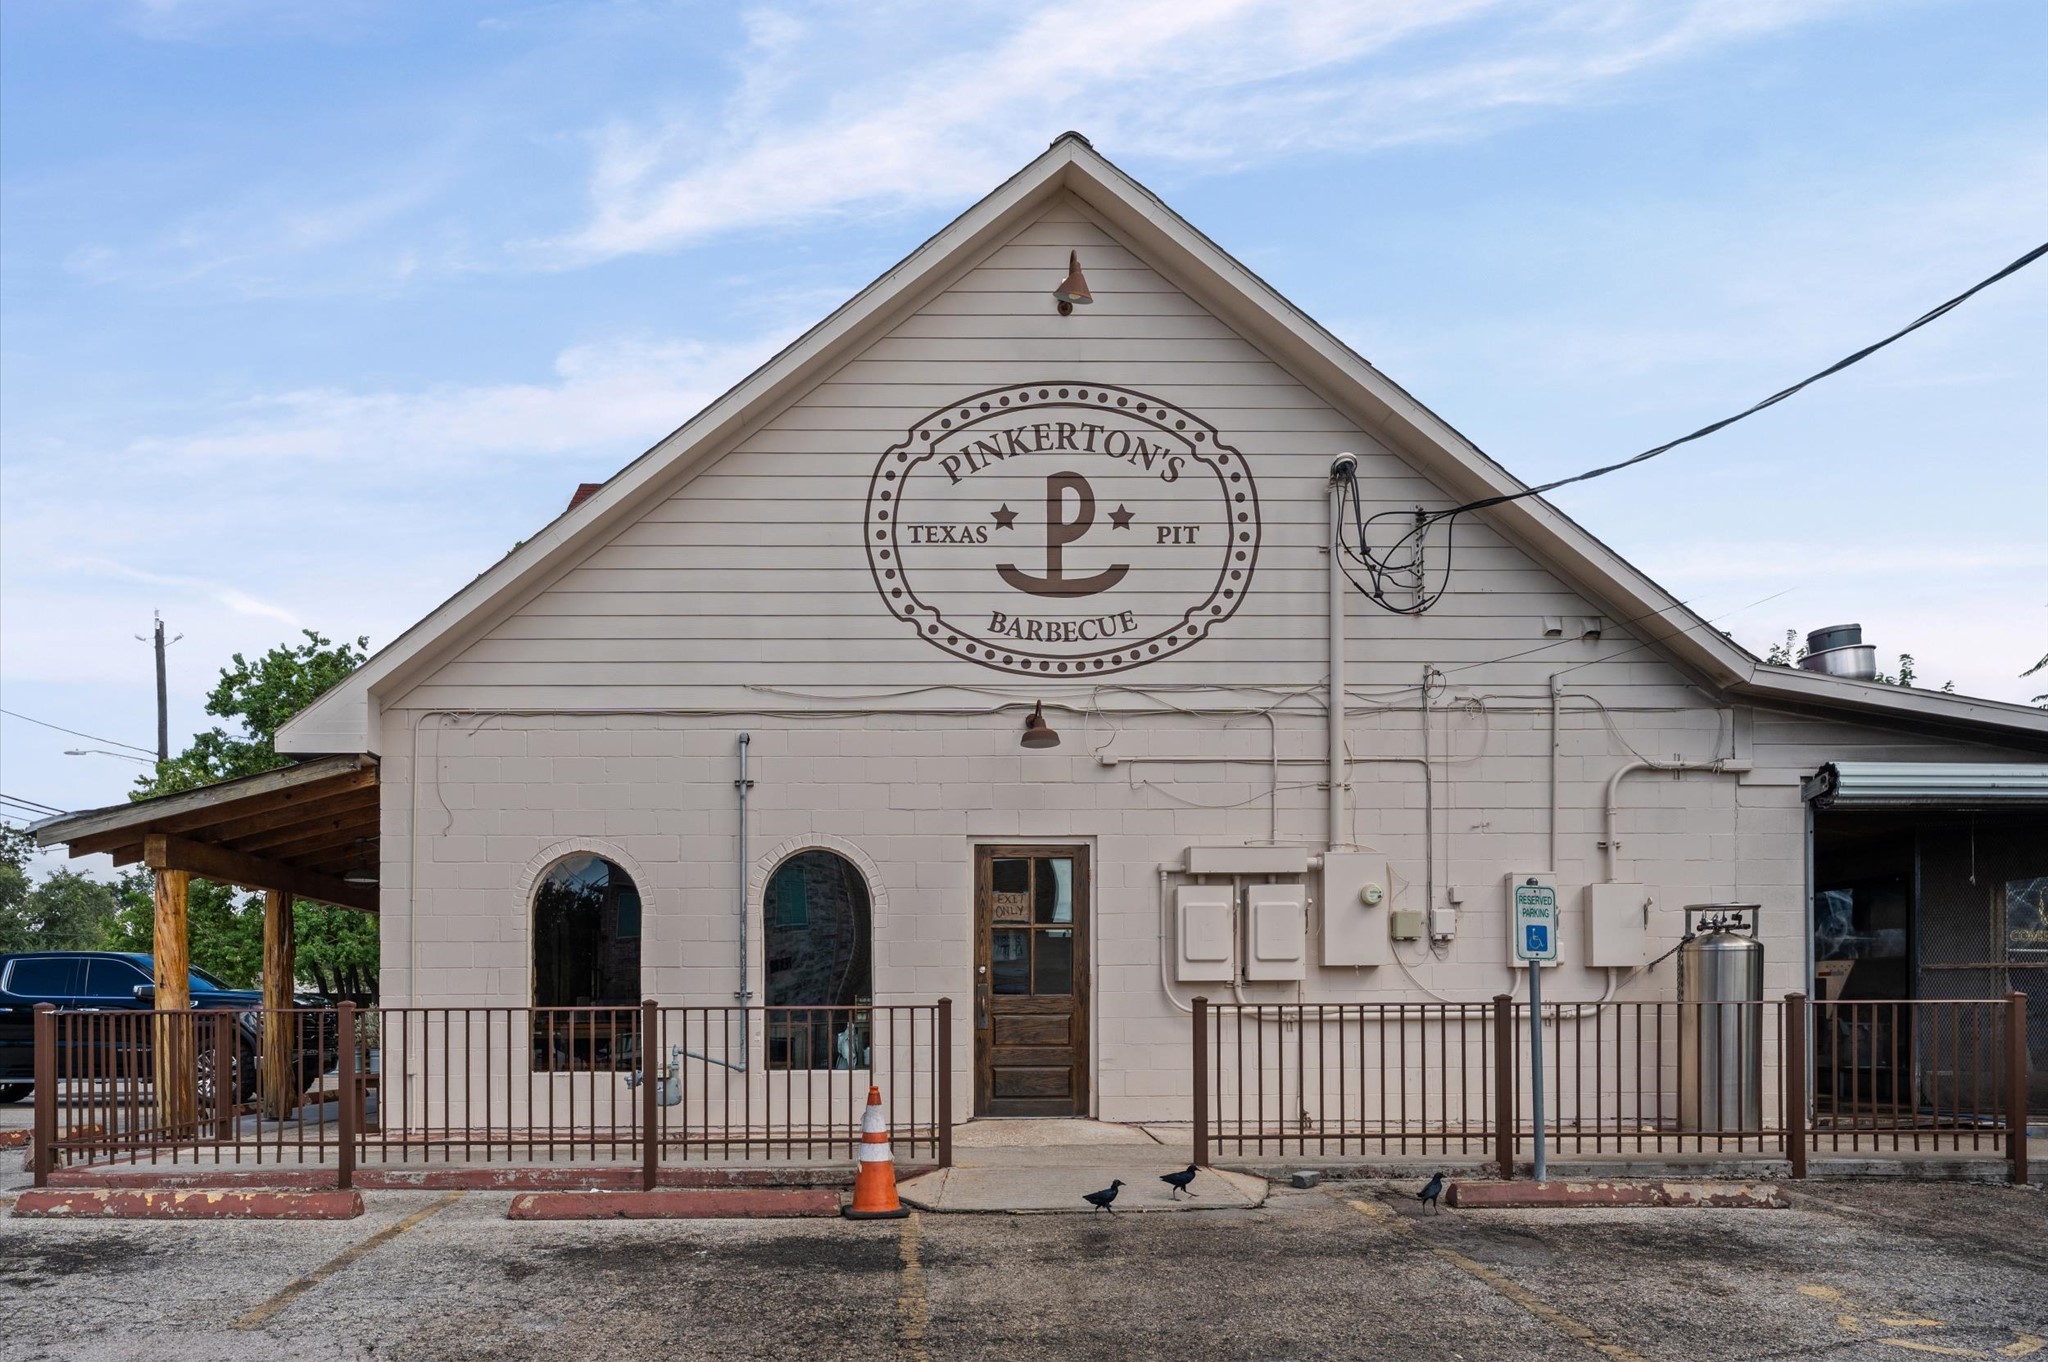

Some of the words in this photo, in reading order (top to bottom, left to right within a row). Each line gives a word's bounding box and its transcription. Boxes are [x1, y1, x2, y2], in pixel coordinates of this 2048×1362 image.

[938, 422, 1186, 485] PINKERTON'S
[907, 525, 989, 544] TEXAS
[1156, 525, 1200, 544] PIT
[986, 610, 1138, 642] BARBECUE
[997, 894, 1024, 904] EXIT
[1518, 895, 1553, 906] RESERVED
[995, 905, 1024, 919] ONLY
[1522, 908, 1550, 918] PARKING
